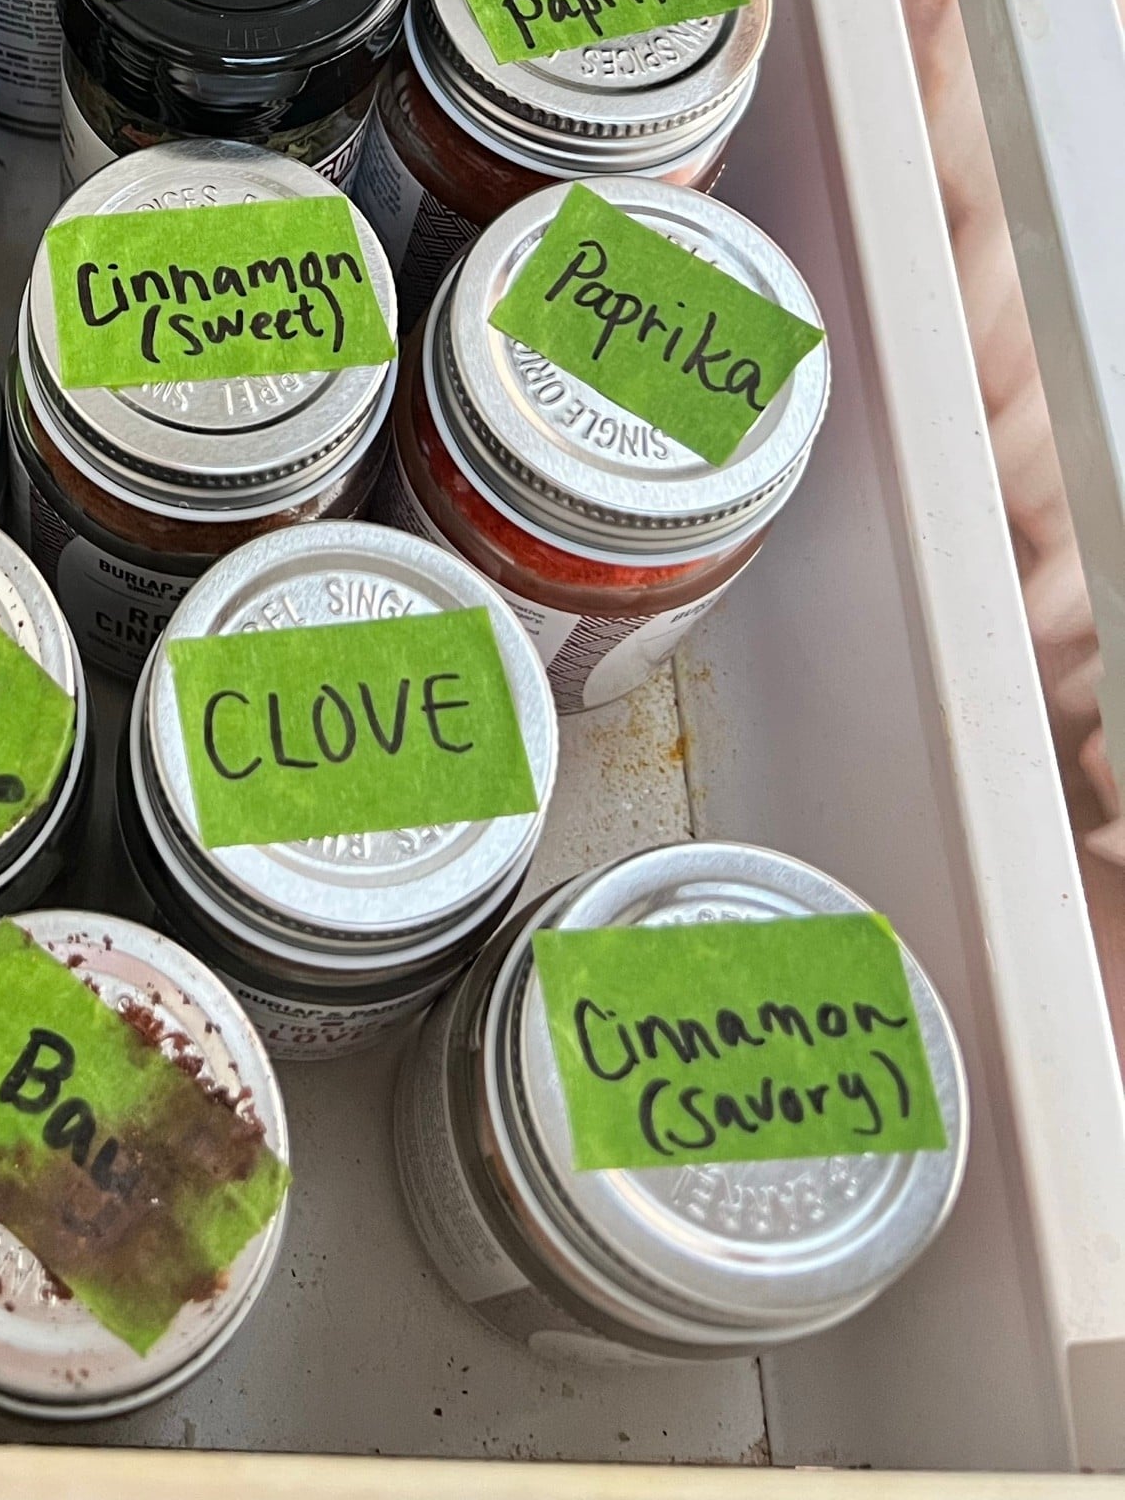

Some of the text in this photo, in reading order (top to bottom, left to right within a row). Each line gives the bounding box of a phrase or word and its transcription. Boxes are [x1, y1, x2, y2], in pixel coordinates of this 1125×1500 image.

[76, 250, 363, 328] Cinnamon
[544, 239, 765, 412] Paprika
[98, 558, 174, 593] BURLAP
[203, 673, 474, 780] CLOVE
[574, 997, 908, 1081] Cinnamon
